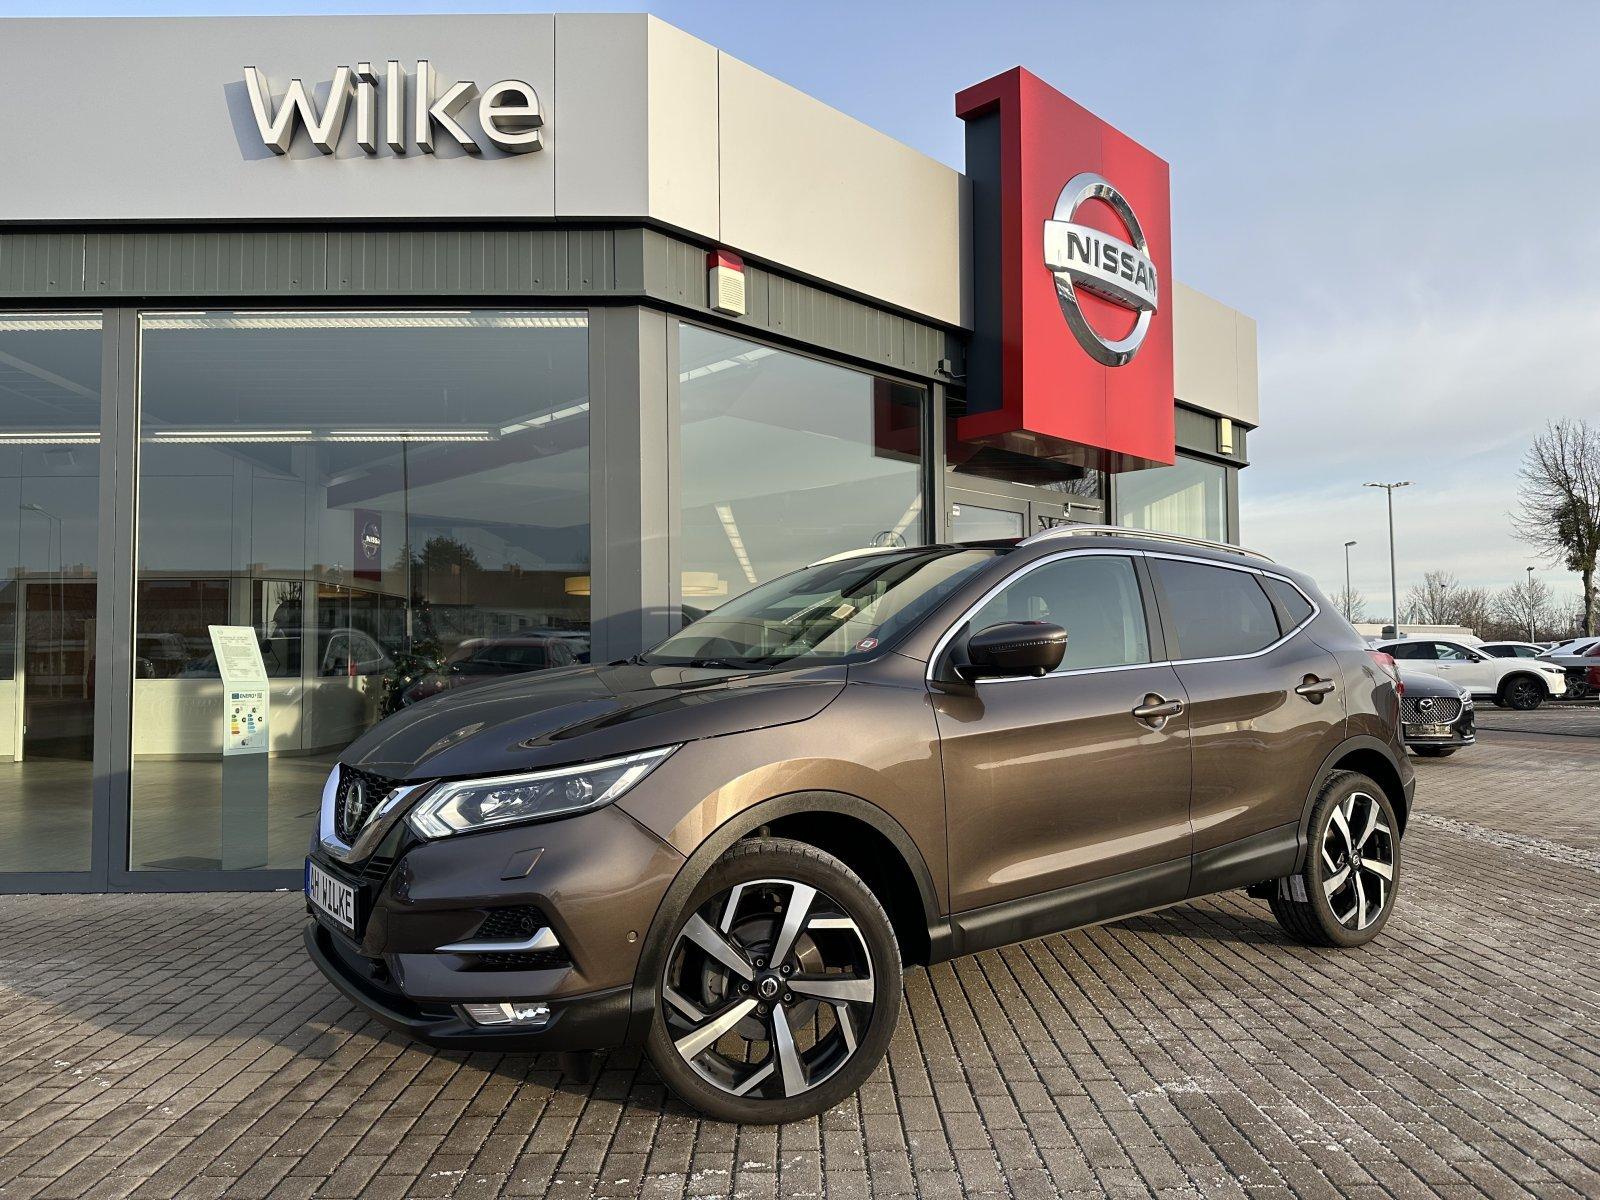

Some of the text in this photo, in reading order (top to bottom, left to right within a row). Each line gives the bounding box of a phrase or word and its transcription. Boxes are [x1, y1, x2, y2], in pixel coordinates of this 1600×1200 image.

[243, 60, 544, 155] Wilke
[1066, 231, 1157, 298] NISSAN
[322, 875, 353, 925] WILKE
